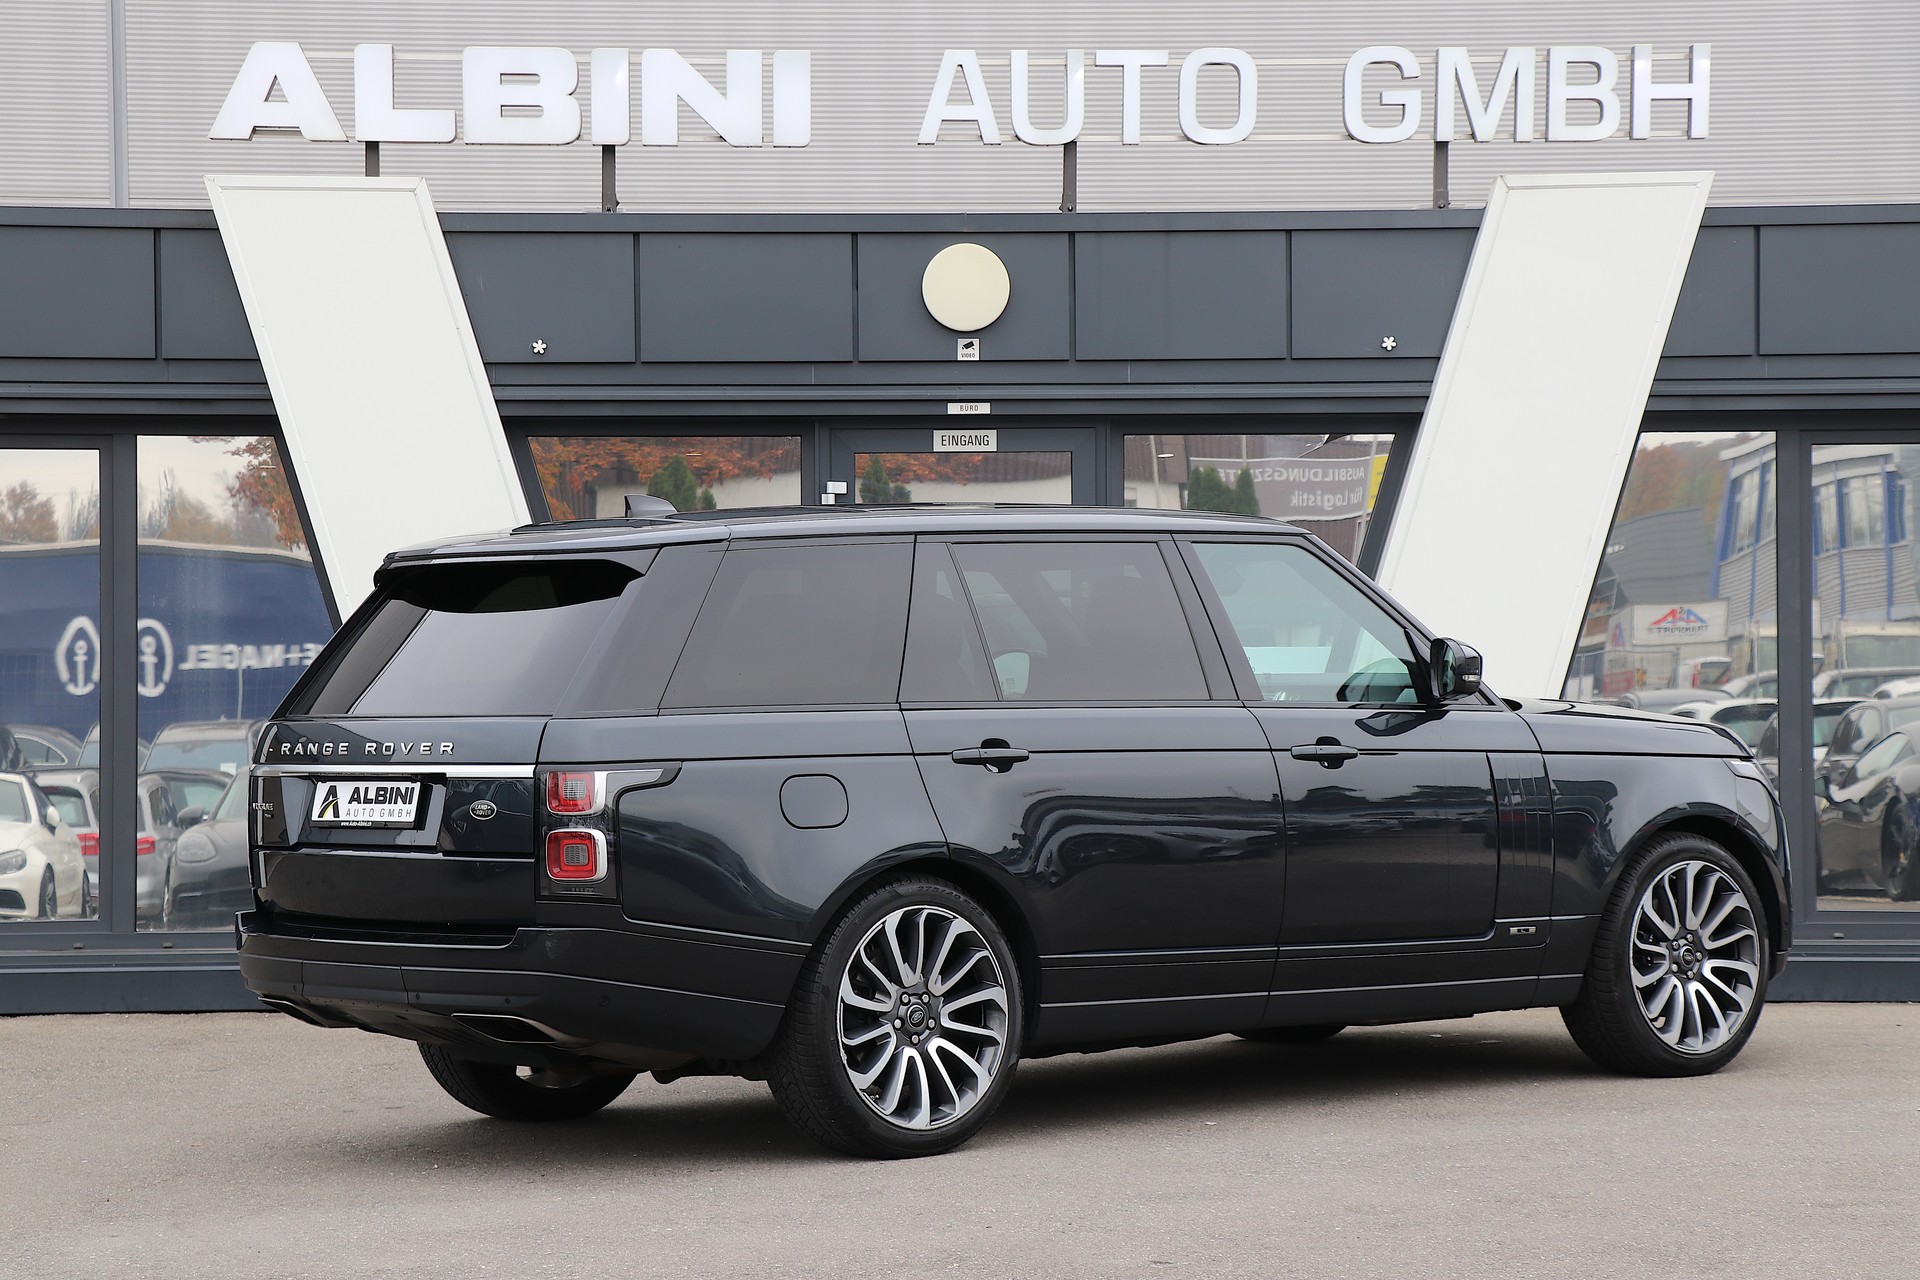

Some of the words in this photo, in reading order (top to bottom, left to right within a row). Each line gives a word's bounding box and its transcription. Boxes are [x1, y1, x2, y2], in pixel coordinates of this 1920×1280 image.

[208, 41, 812, 147] ALBINI
[917, 47, 1259, 146] AUTO
[1343, 43, 1711, 143] GMBH
[960, 404, 979, 412] BÜRO
[941, 434, 990, 446] EINGANG
[280, 742, 349, 756] RANGE
[364, 742, 456, 756] ROVER
[349, 786, 415, 806] ALBINI
[345, 807, 375, 818] AUTO
[379, 807, 413, 818] GMBH
